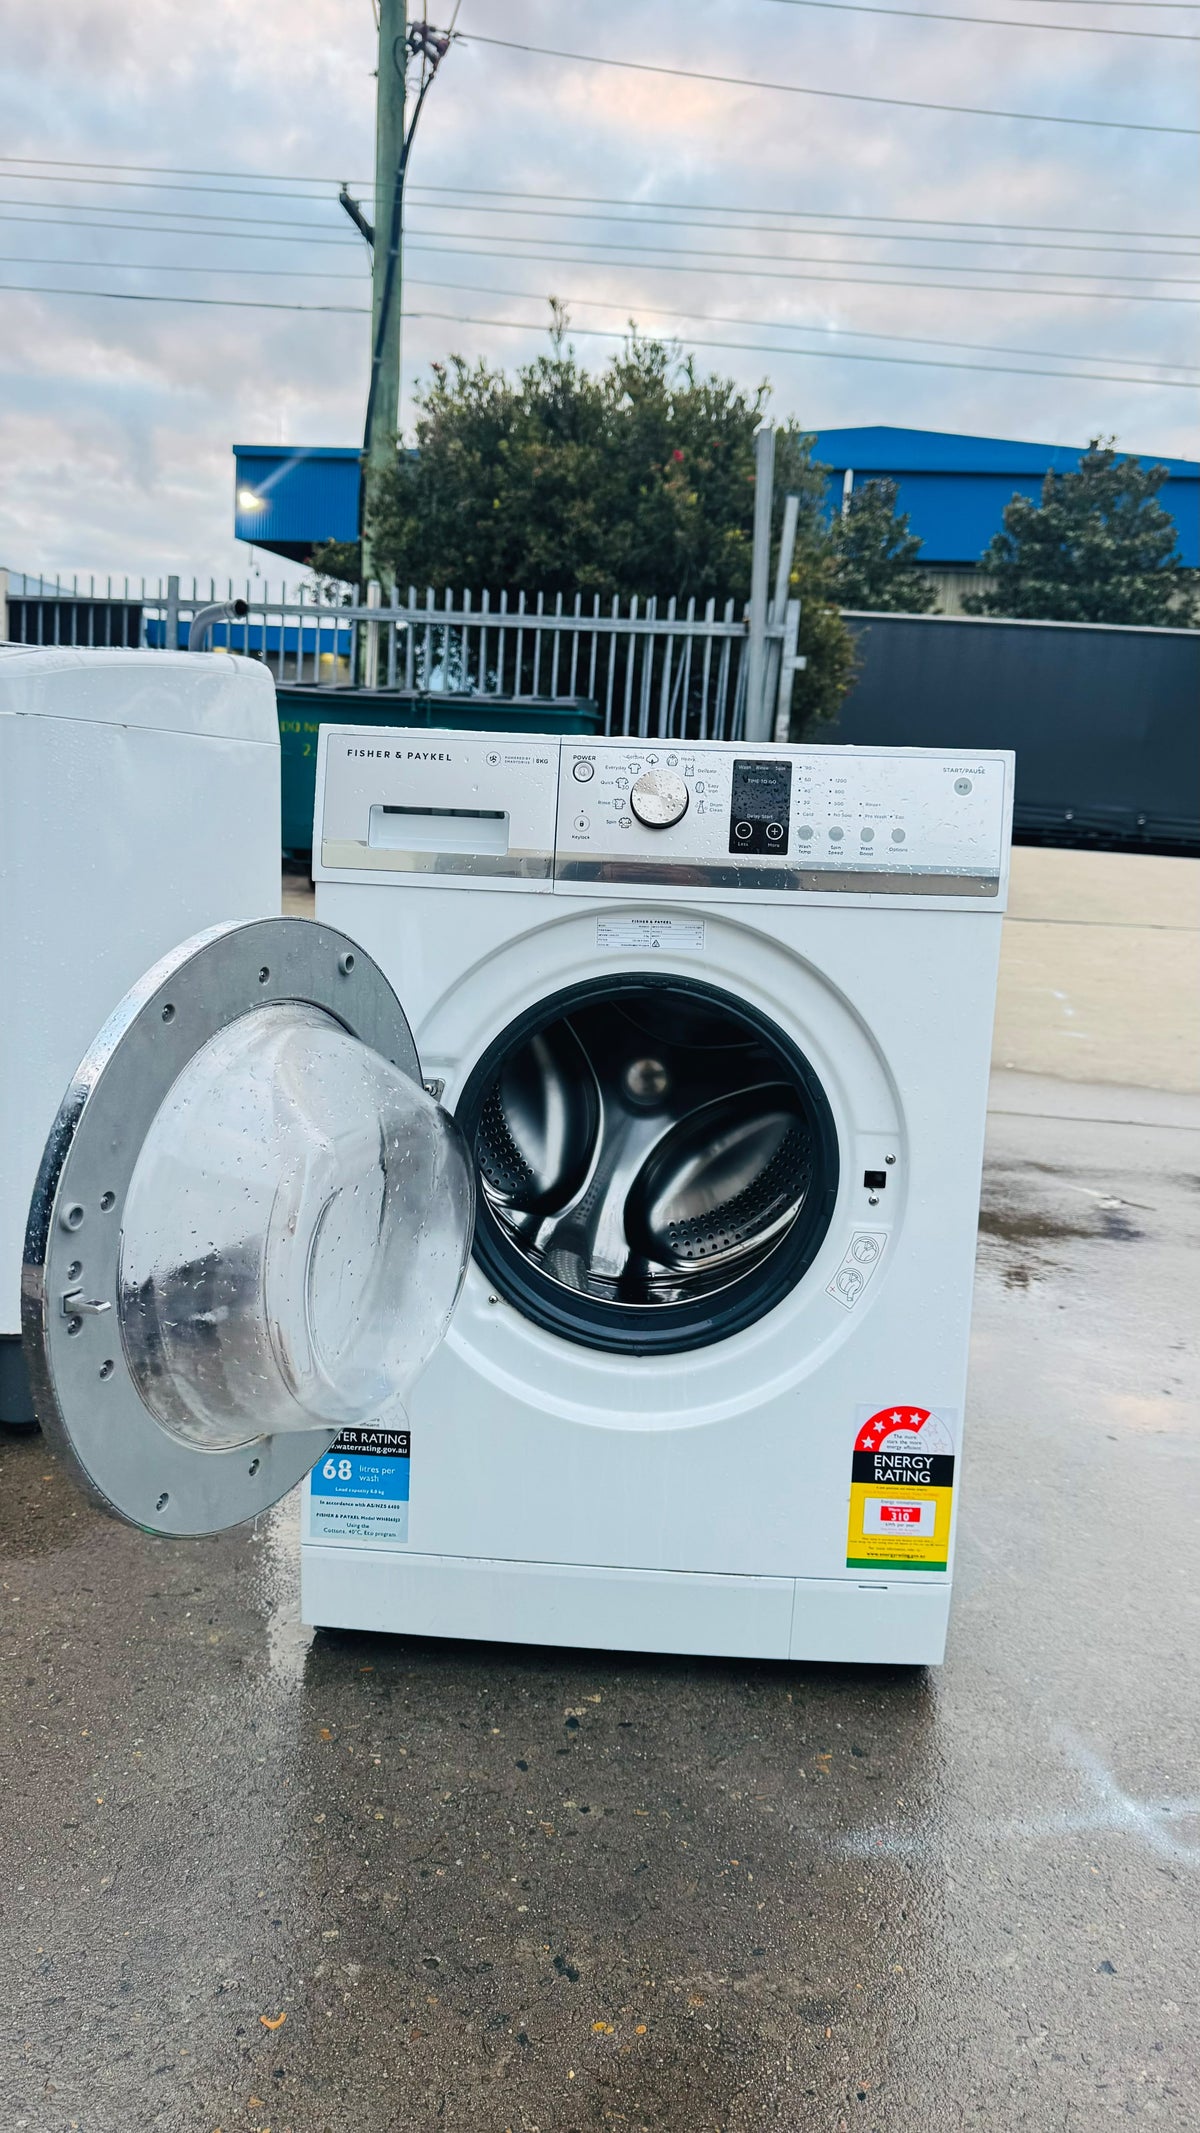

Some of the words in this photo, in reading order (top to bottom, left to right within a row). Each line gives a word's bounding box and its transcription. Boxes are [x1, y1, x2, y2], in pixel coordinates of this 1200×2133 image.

[347, 749, 391, 759] FISHER
[395, 751, 402, 759] &
[407, 752, 452, 761] PAYKEL
[361, 1432, 407, 1446] RATING
[873, 1454, 934, 1470] ENERGY
[322, 1458, 352, 1481] 68
[359, 1465, 379, 1474] litres
[382, 1467, 395, 1476] per
[874, 1468, 931, 1483] RATING
[359, 1475, 379, 1483] wash
[890, 1512, 910, 1522] 310
